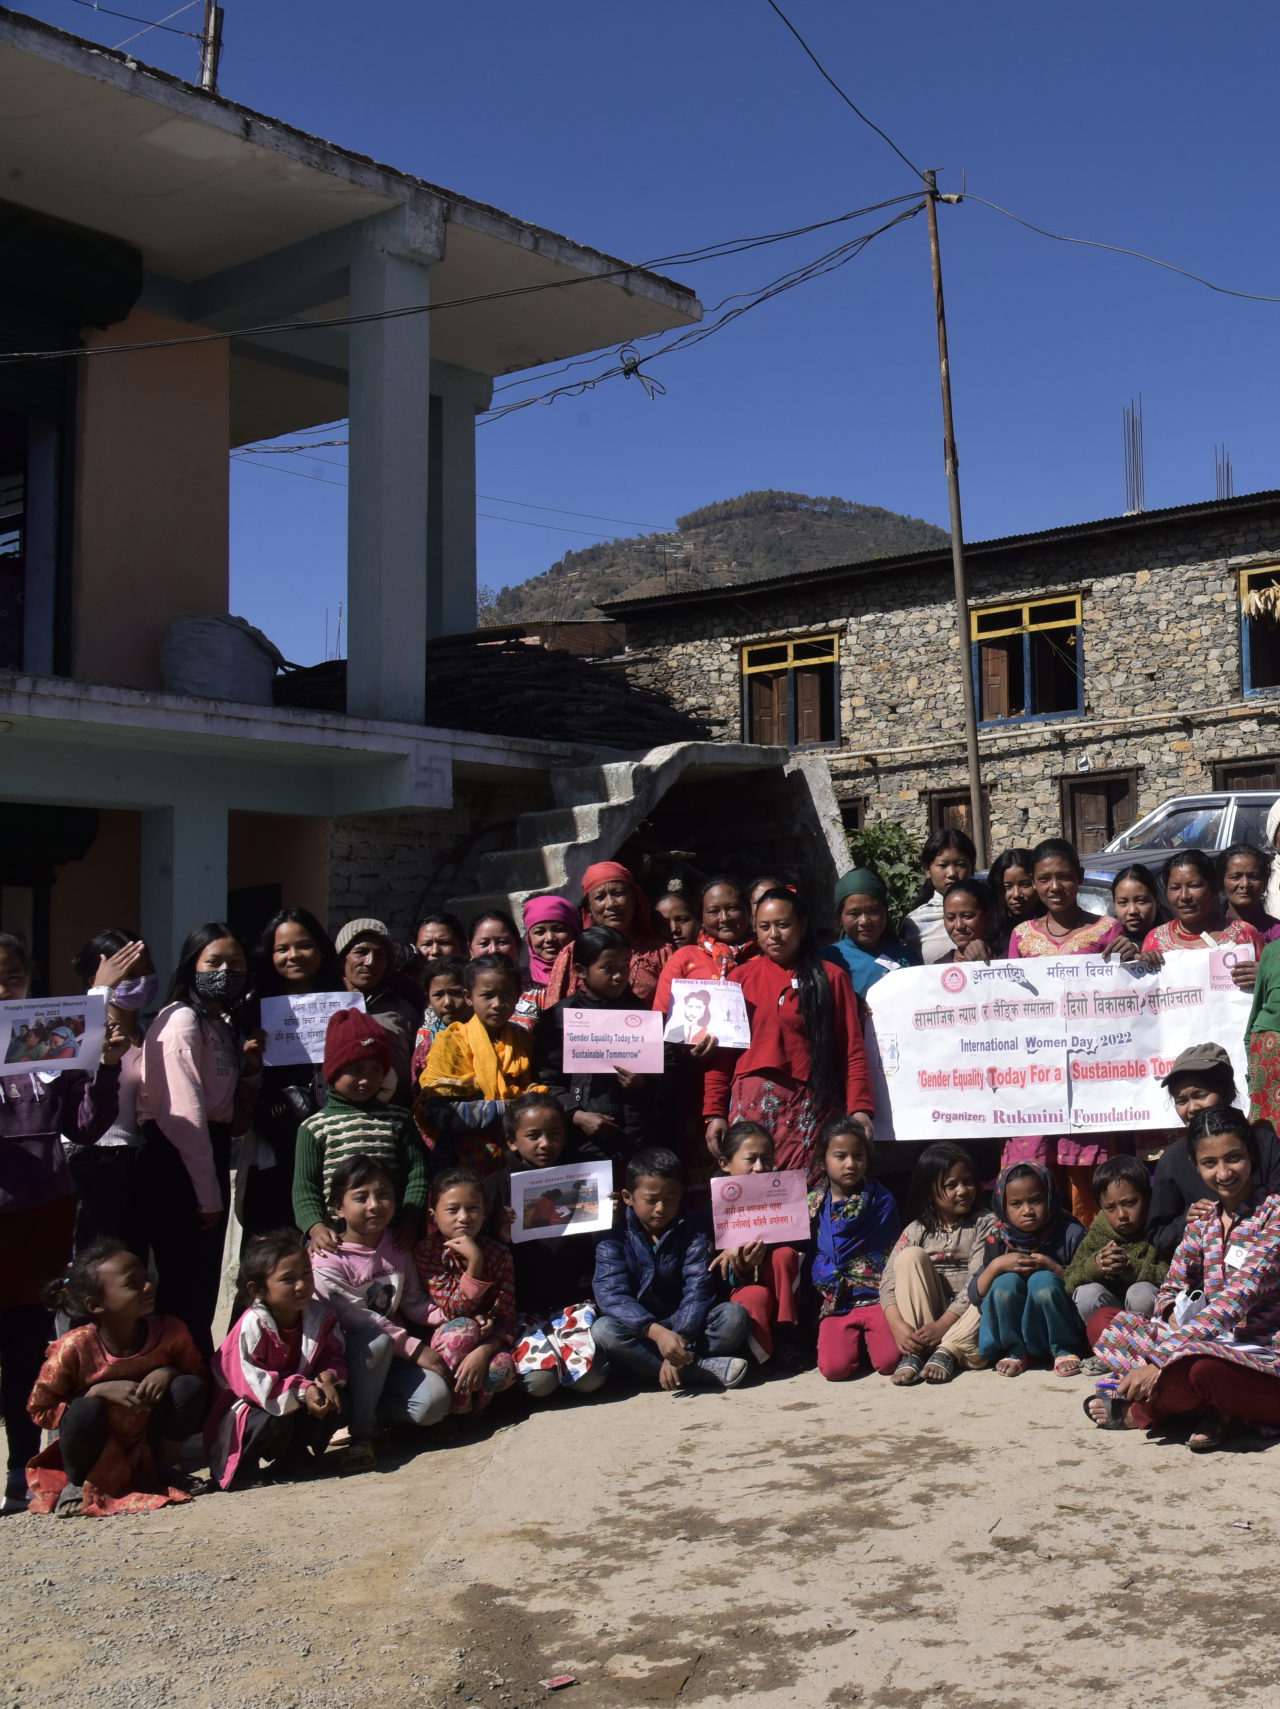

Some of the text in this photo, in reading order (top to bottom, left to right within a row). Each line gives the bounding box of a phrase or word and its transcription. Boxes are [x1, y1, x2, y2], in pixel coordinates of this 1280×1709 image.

[1046, 962, 1079, 979] महिला
[1086, 961, 1113, 977] दिवस
[914, 1005, 954, 1028] सामाजिक
[959, 1007, 977, 1022] न्याय
[981, 1005, 989, 1021] र
[1023, 1001, 1055, 1017] समानता
[1093, 990, 1140, 1015] विकासको
[590, 1033, 613, 1044] Equality
[614, 1034, 631, 1044] Today
[960, 1031, 1132, 1053] International Women Day 2022
[571, 1049, 605, 1059] Sustainable
[952, 1068, 984, 1091] Equality
[988, 1066, 1027, 1089] Today
[1030, 1065, 1051, 1083] For
[1054, 1067, 1062, 1081] a
[1072, 1060, 1147, 1080] Sustainable
[993, 1108, 1064, 1124] Rukmini
[1073, 1106, 1150, 1124] Foundation
